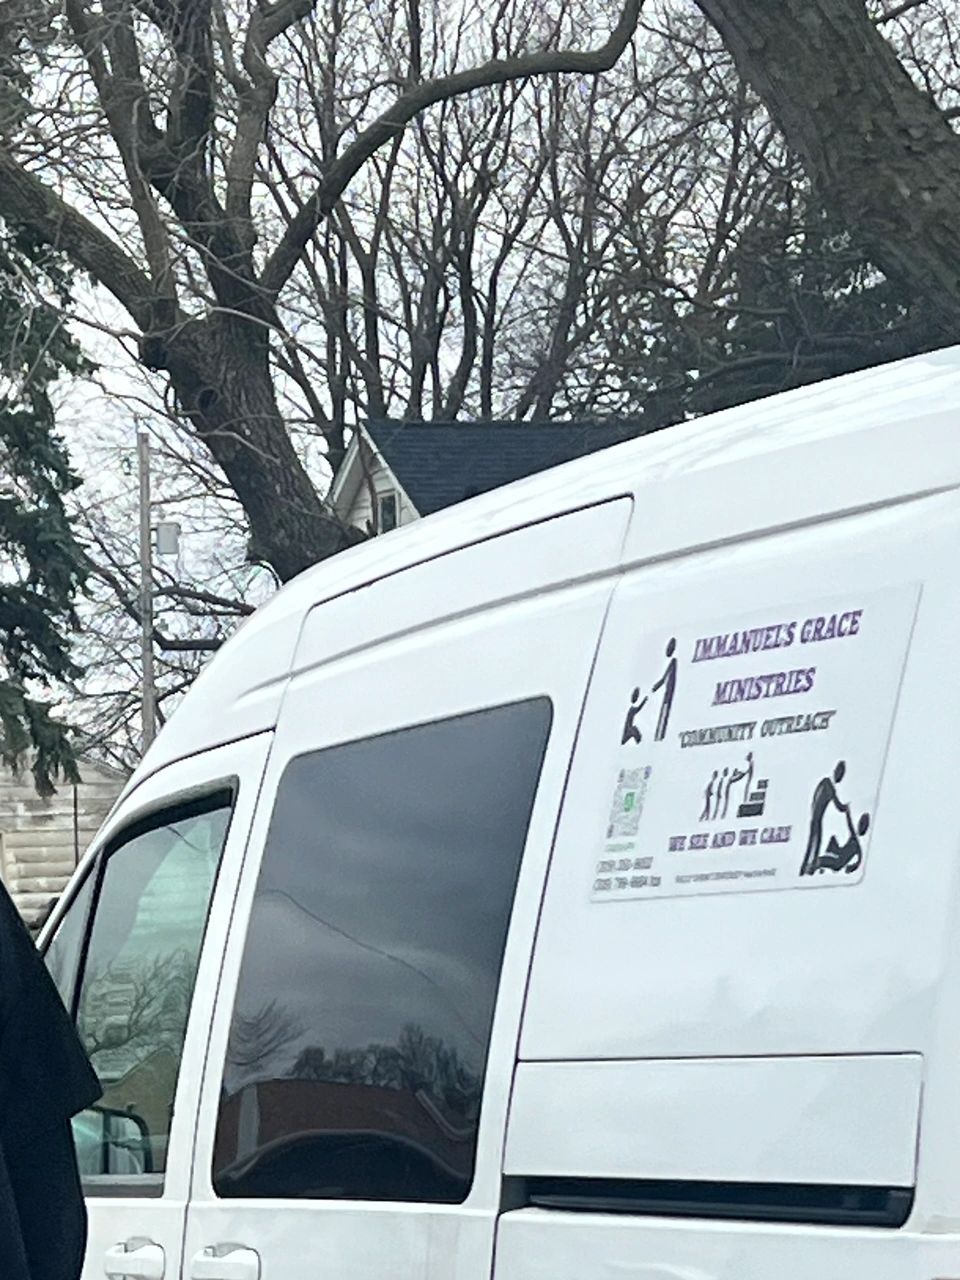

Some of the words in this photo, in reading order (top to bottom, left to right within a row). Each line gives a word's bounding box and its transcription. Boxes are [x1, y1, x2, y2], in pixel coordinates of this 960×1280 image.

[691, 621, 797, 663] IMMANUEL'S
[800, 609, 864, 644] GRACE
[711, 667, 816, 706] MINISTRIES
[678, 720, 757, 748] COMMUNITY
[760, 710, 837, 738] OUTREACH
[668, 835, 687, 852] WE
[710, 831, 736, 849] AND
[738, 828, 759, 846] WE
